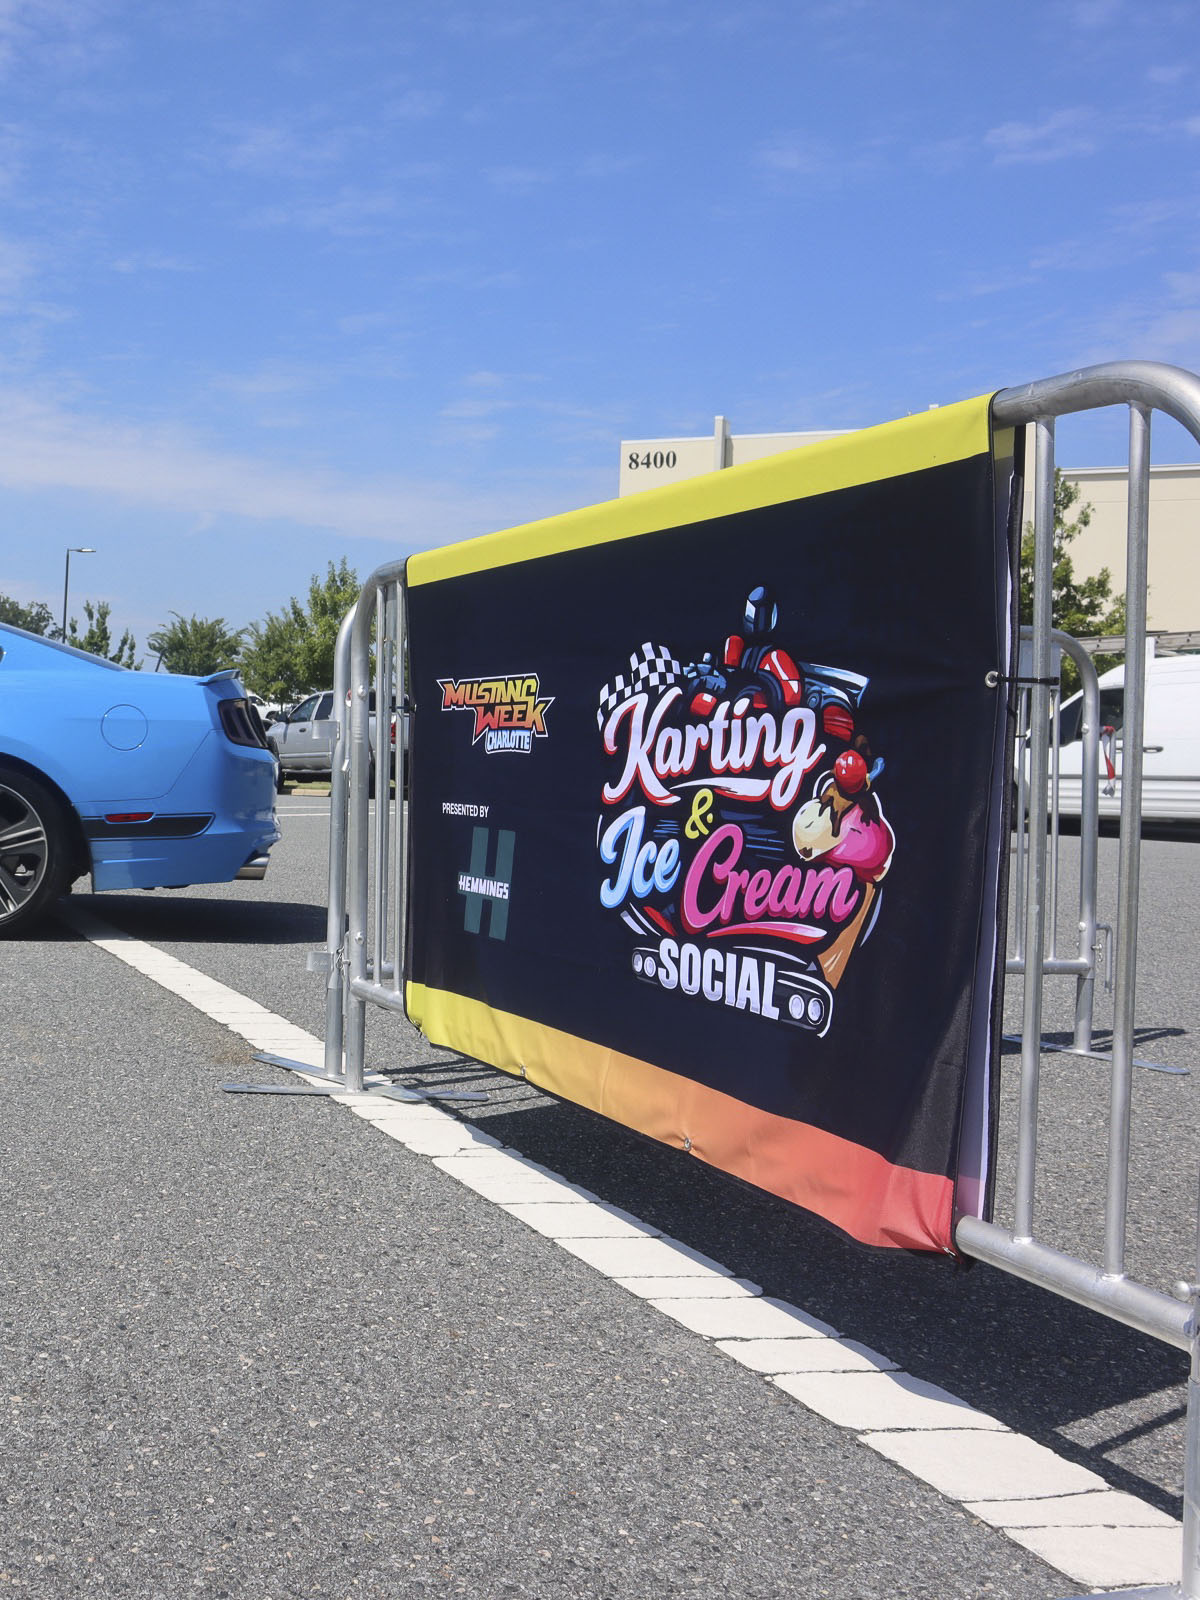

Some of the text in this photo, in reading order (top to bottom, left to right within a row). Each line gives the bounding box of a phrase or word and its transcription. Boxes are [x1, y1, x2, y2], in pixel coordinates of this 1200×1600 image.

[628, 450, 677, 470] 8400
[443, 678, 537, 706] MUSTANG
[475, 703, 546, 736] WEEK
[486, 729, 531, 750] CHARLOTTE
[602, 686, 827, 810] Karting
[442, 802, 490, 818] PRESENTED BY
[685, 788, 714, 839] &
[600, 805, 860, 934] Ice Cream
[458, 874, 510, 899] HEMMINGS
[658, 937, 780, 1020] SOCIAL
